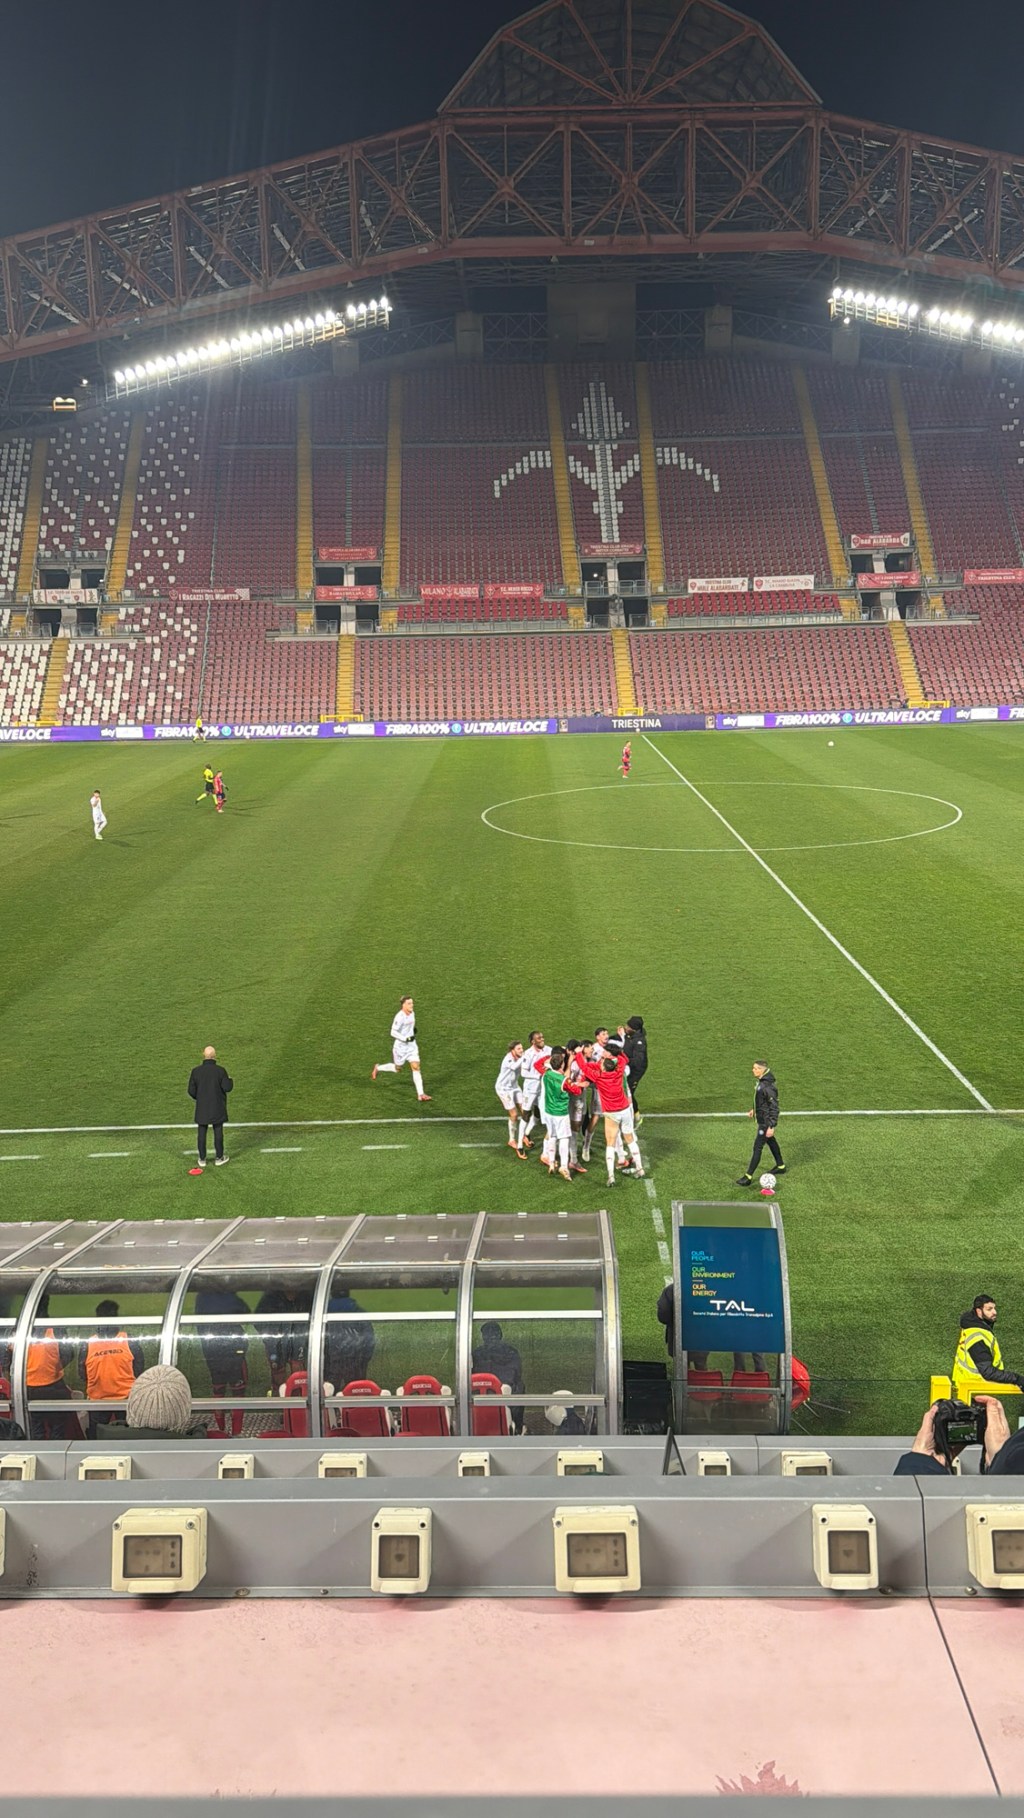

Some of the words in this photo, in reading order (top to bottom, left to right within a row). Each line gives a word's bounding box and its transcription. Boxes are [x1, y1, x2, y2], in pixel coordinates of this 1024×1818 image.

[854, 710, 942, 723] ULTRAVELOCE
[956, 709, 970, 719] sky
[464, 721, 548, 734] ULTRAVELOCE
[612, 719, 661, 728] TRIESTINA
[723, 717, 737, 727] sky
[101, 728, 116, 739] sky
[234, 725, 319, 737] ULTRAVELOCE
[334, 724, 347, 734] sky
[710, 1300, 754, 1311] TAL
